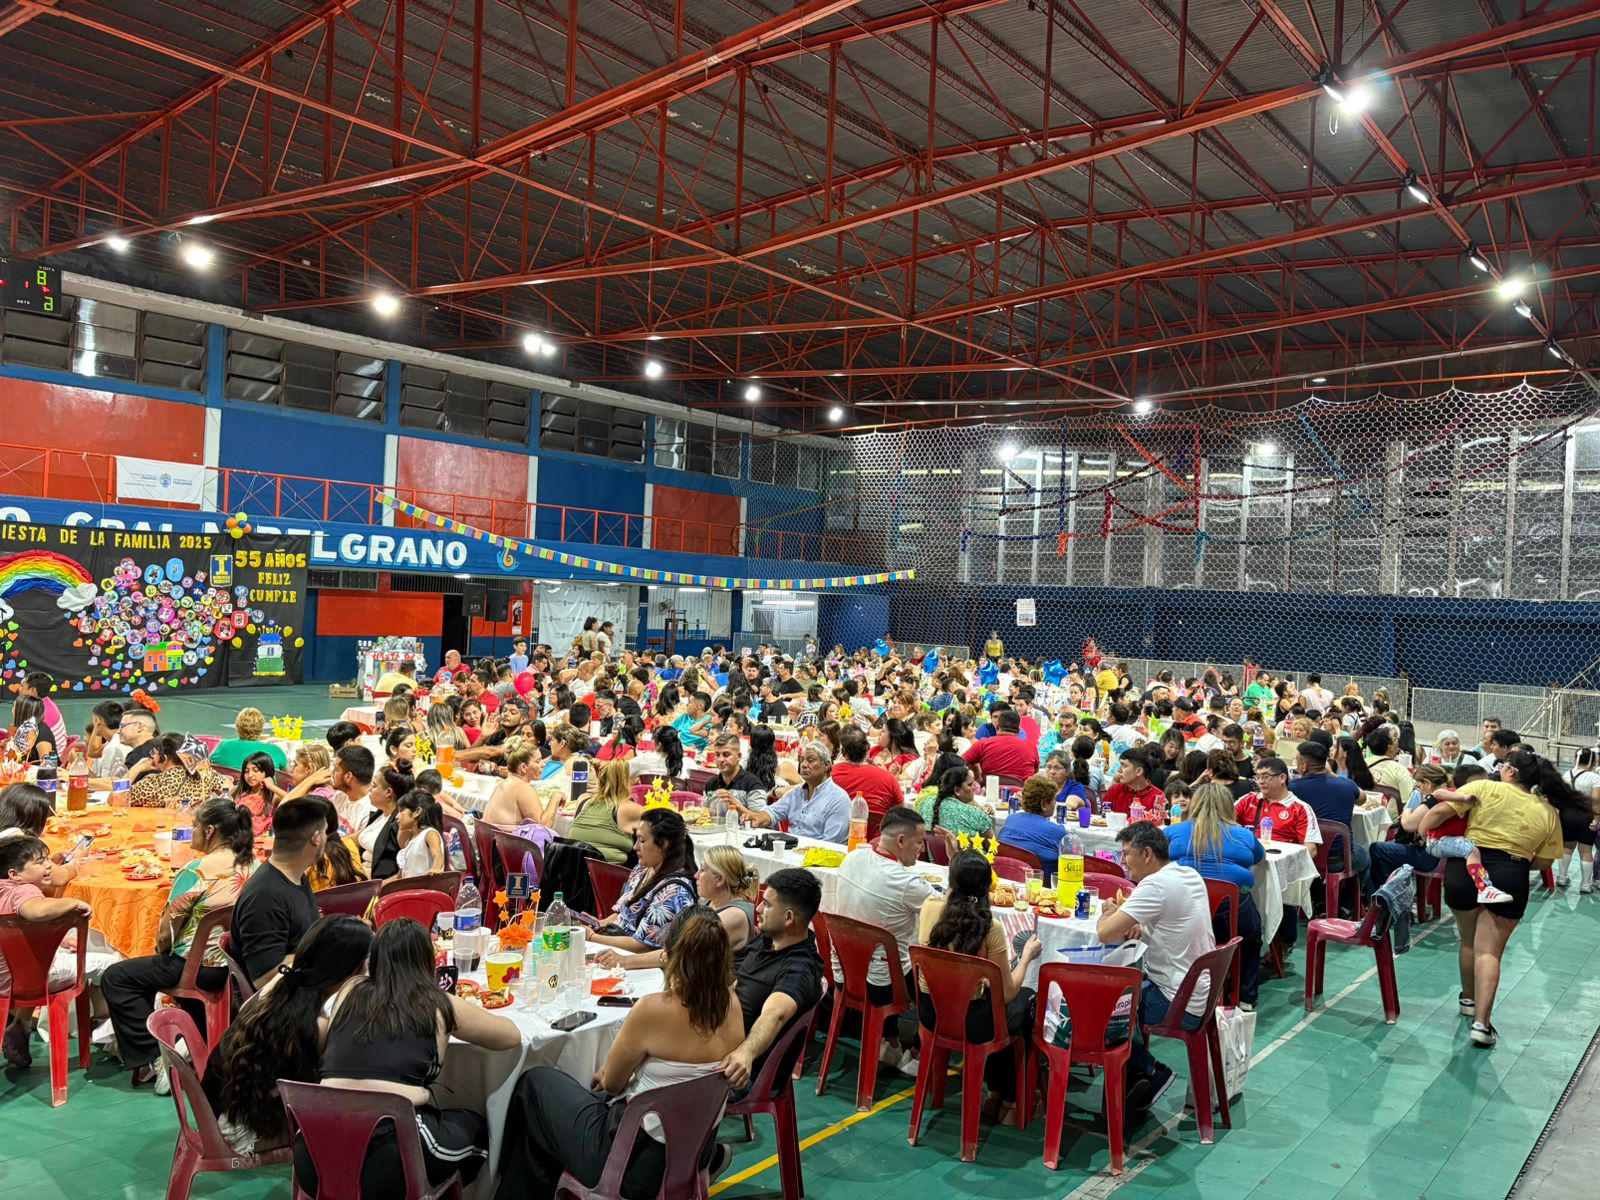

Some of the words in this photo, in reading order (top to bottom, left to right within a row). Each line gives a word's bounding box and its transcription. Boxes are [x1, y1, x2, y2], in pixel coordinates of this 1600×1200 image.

[1, 524, 47, 543] IESTA
[60, 528, 78, 544] DE
[90, 530, 105, 546] LA
[115, 533, 171, 549] FAMILIA
[179, 535, 212, 549] 2025
[257, 526, 468, 570] LGRANO
[235, 550, 261, 567] 55
[265, 549, 306, 568] AÑOS
[258, 572, 291, 586] FELIZ
[249, 589, 297, 603] CUMPLE
